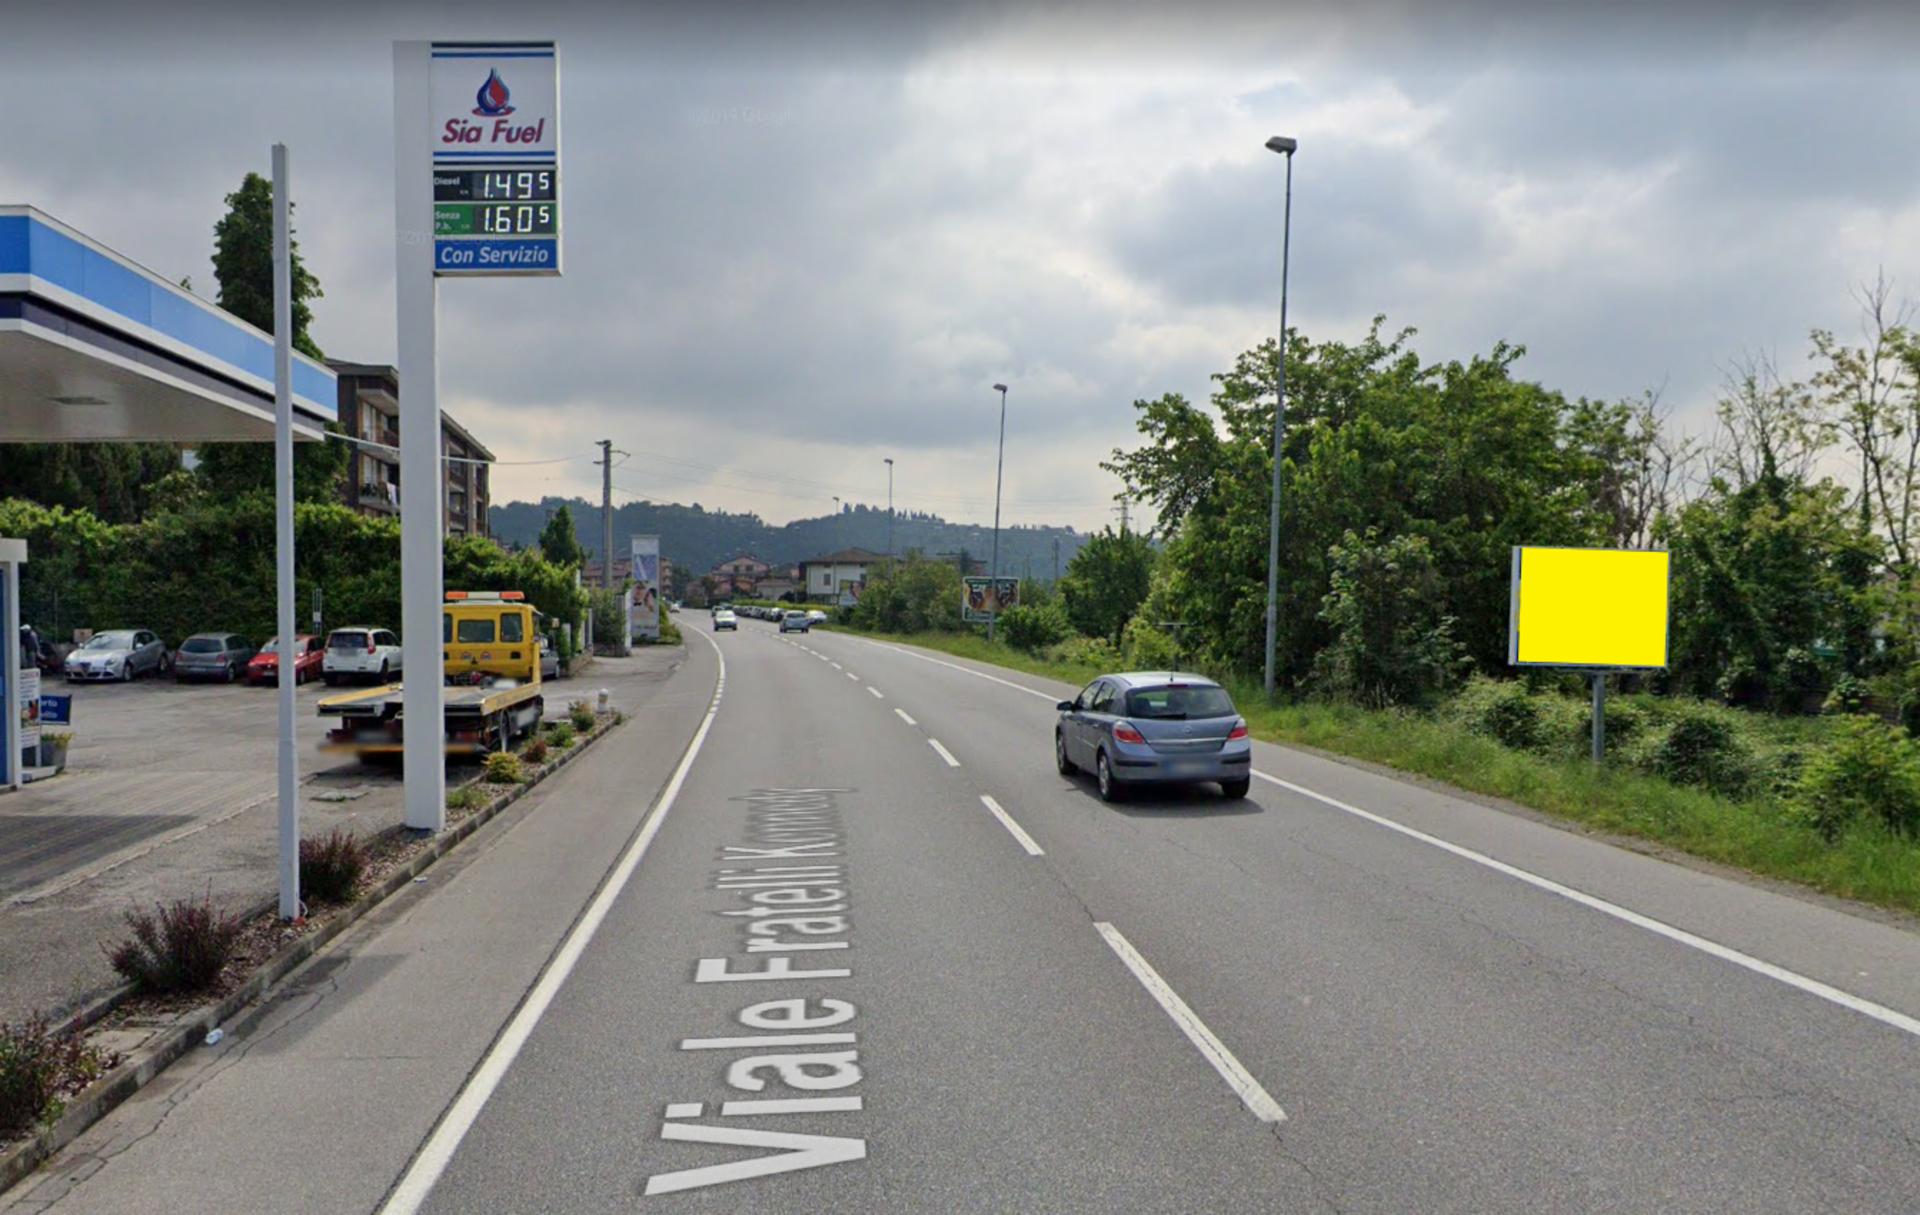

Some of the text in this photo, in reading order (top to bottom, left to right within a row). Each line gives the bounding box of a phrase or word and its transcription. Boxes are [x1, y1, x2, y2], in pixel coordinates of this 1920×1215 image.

[442, 117, 545, 143] Sia Fuel
[434, 176, 460, 186] Diesel
[441, 246, 549, 263] Con Servizio
